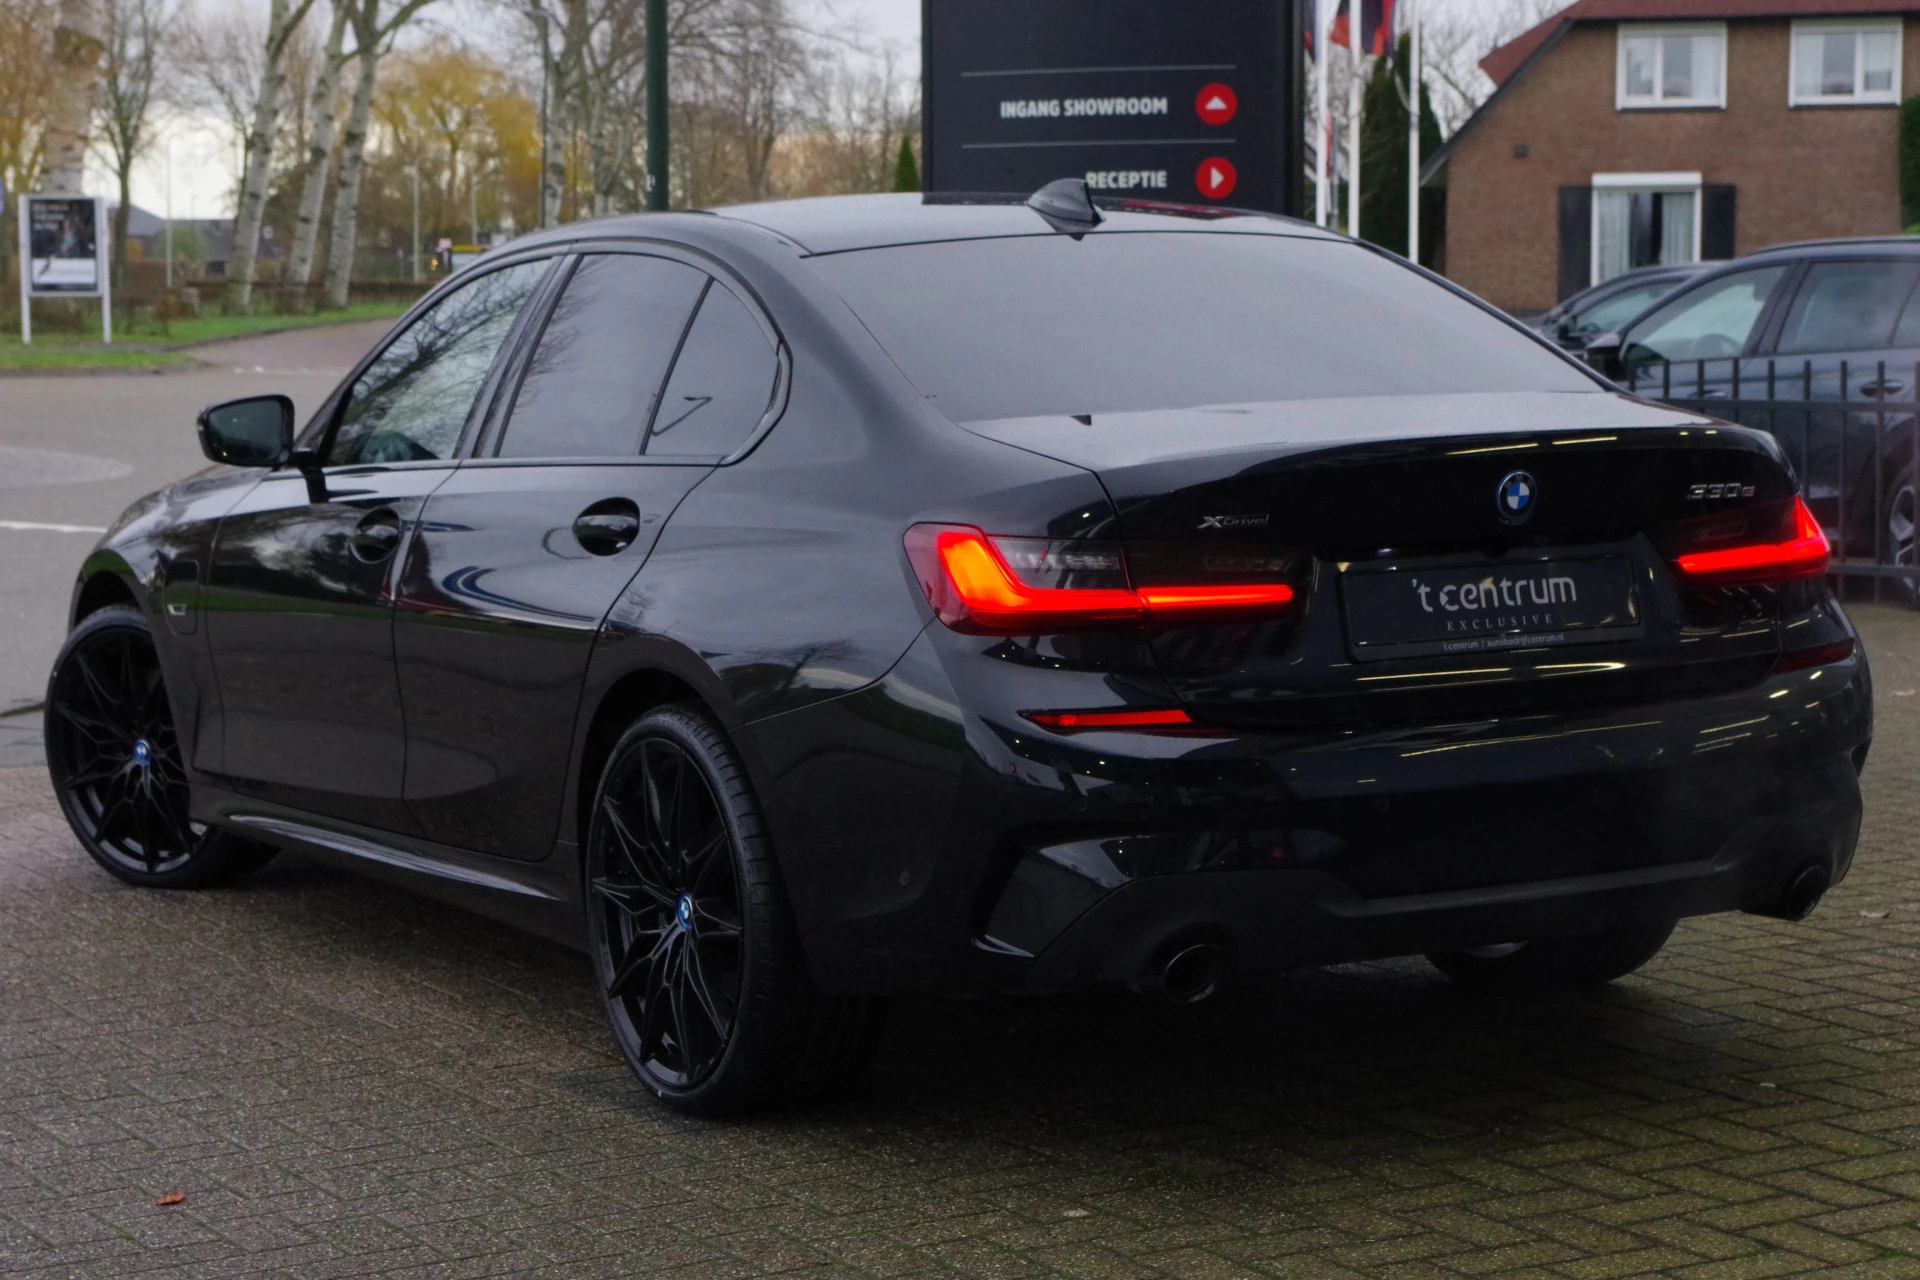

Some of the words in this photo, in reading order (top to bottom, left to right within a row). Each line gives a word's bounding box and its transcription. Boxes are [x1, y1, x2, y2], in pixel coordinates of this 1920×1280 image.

[1000, 99, 1061, 119] INGANG
[1064, 97, 1168, 117] SHOWROOM
[1086, 170, 1168, 189] RECEPTIE
[1439, 576, 1577, 611] centrum
[1447, 613, 1554, 632] EXCLUSIVE
